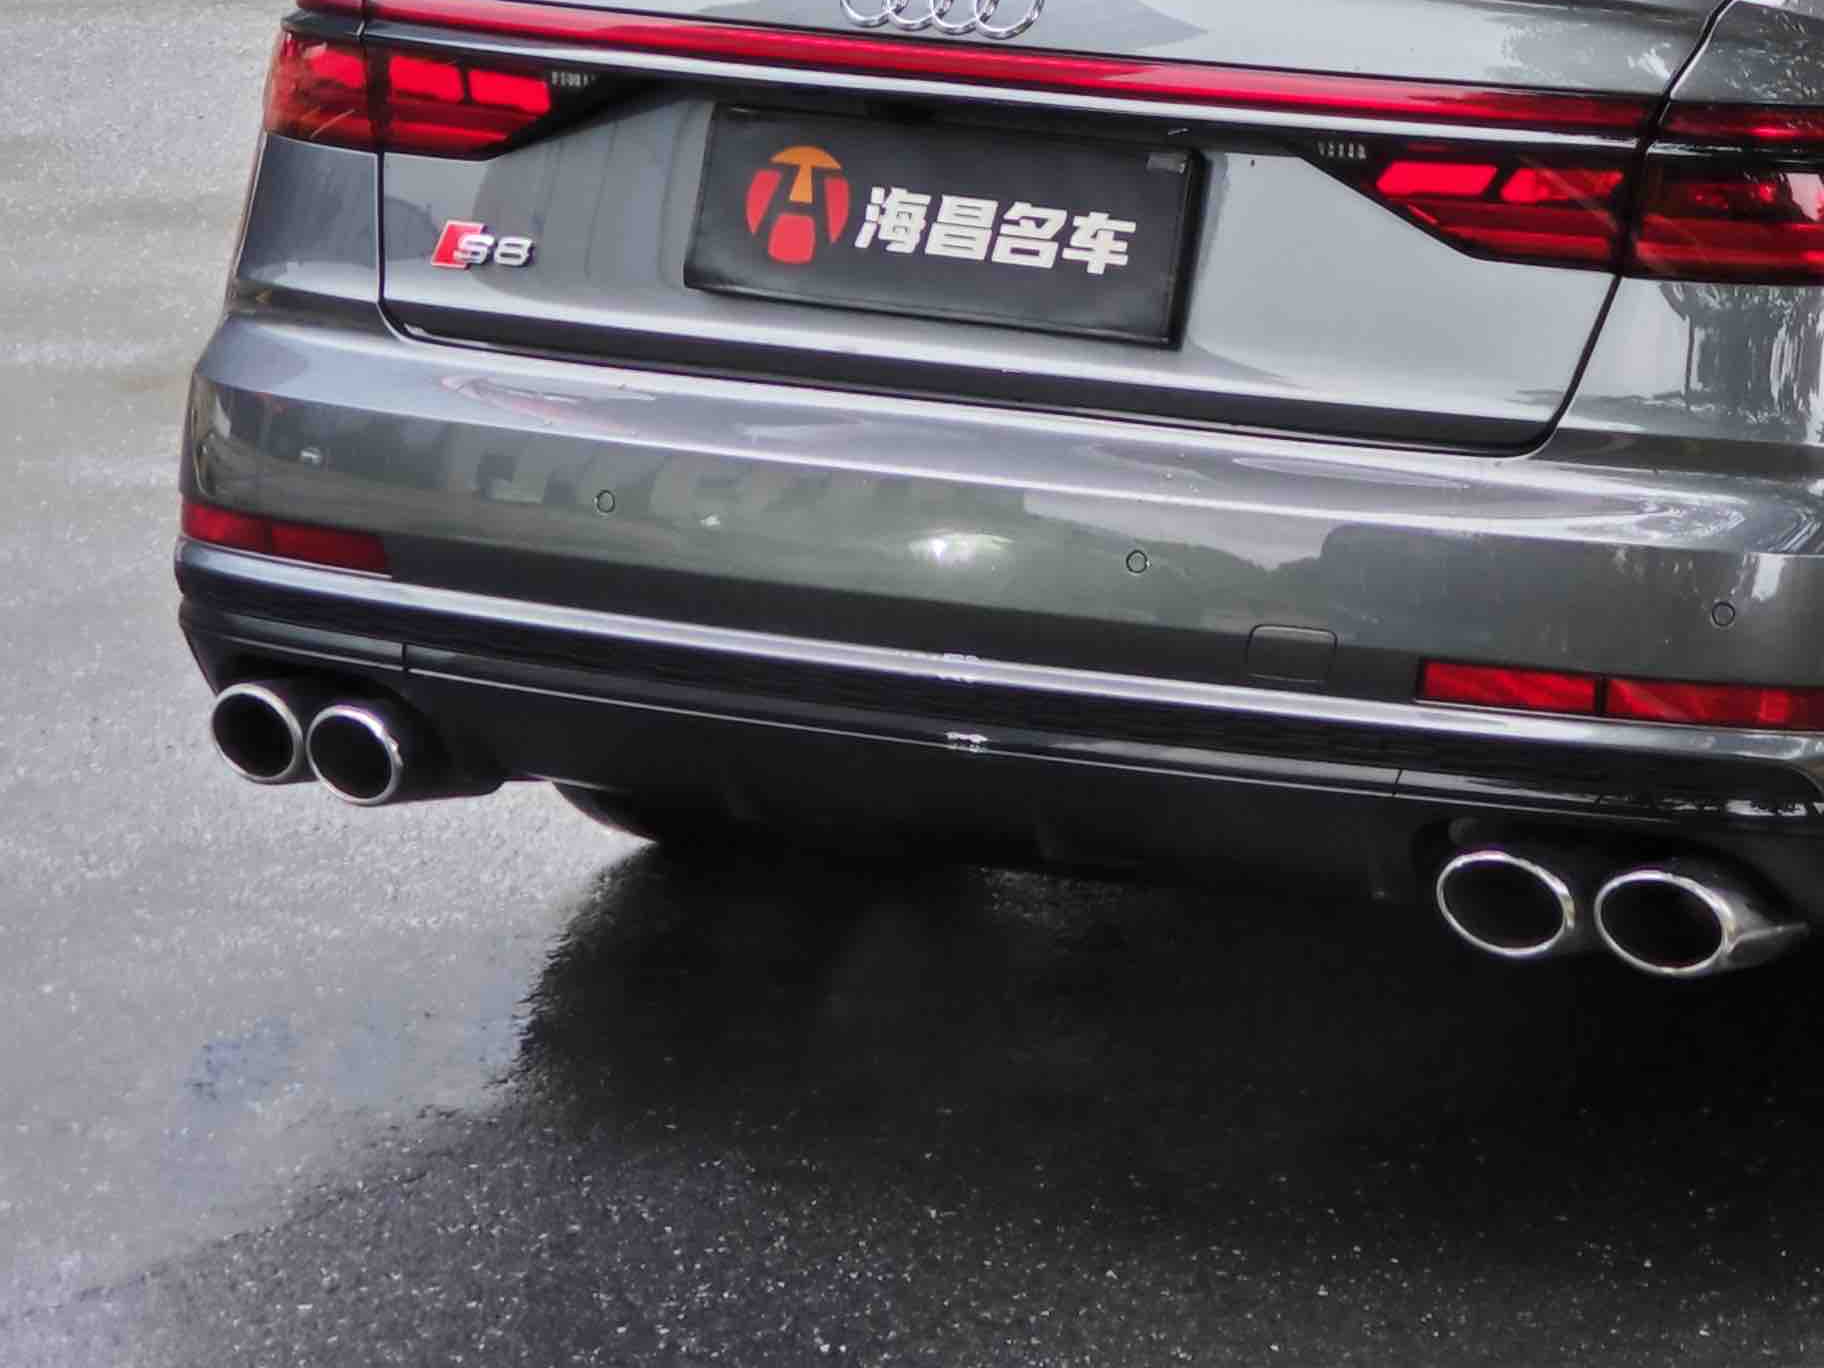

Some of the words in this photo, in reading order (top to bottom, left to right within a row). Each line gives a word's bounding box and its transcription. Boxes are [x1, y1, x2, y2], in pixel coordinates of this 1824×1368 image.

[452, 233, 534, 267] S8
[853, 185, 1138, 275] 海昌名车
